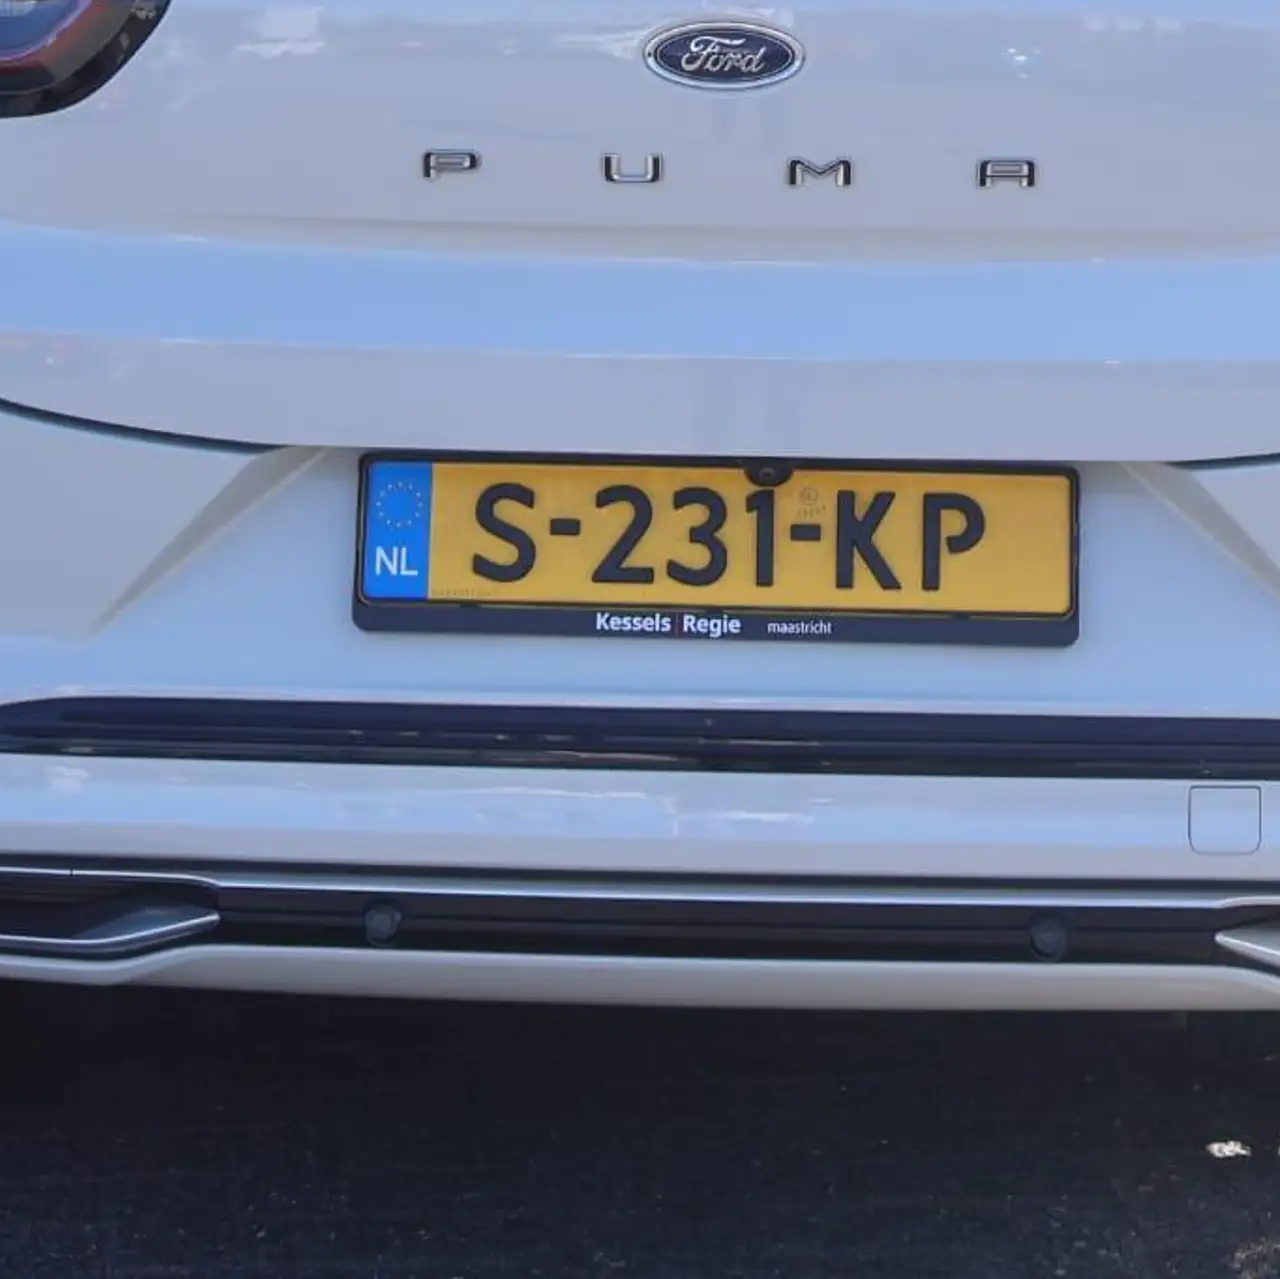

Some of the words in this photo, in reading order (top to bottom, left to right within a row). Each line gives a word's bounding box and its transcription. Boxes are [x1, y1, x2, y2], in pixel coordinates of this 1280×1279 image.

[681, 36, 767, 72] Ford
[423, 151, 1037, 187] PUMA
[472, 481, 987, 591] S-231-KP
[375, 546, 419, 577] NL
[595, 612, 672, 633] Kessels
[682, 614, 742, 638] Regie
[766, 619, 833, 635] maastricht
